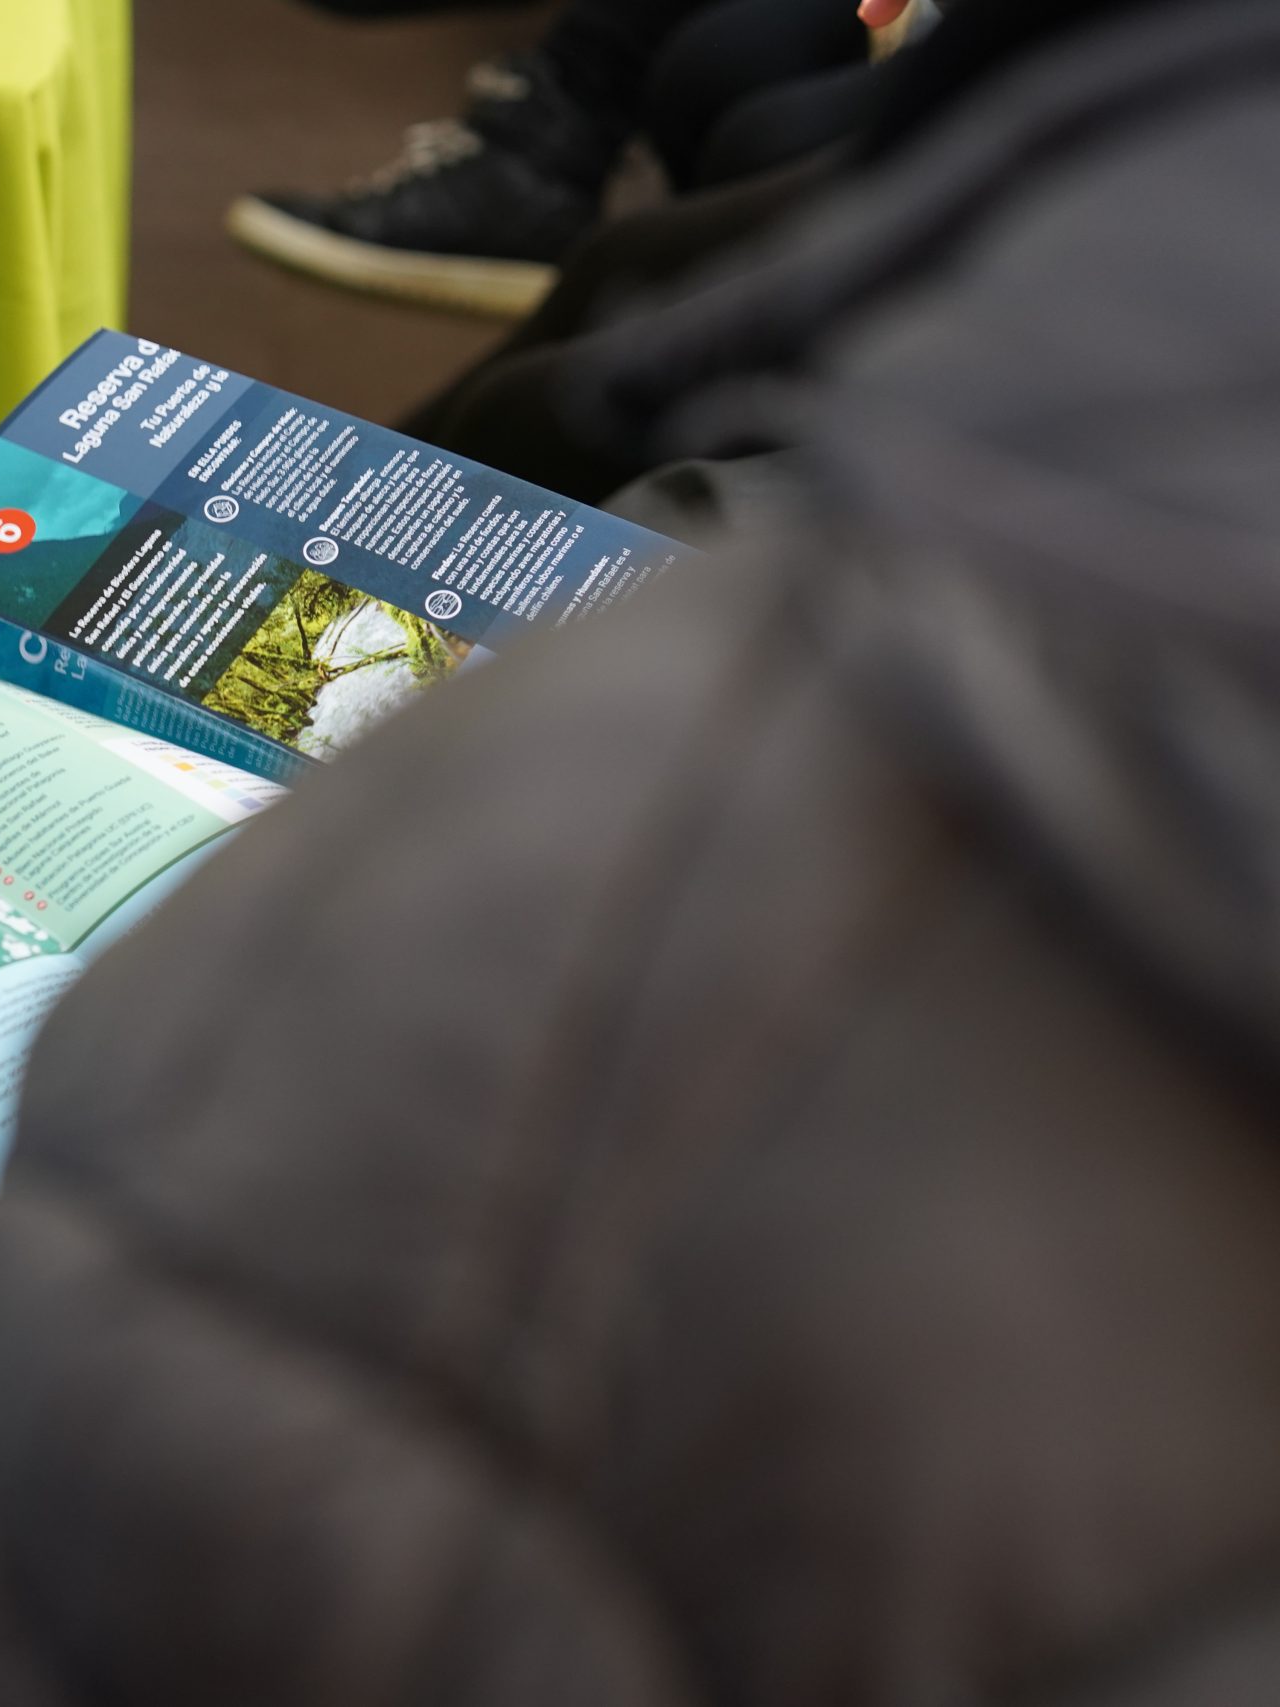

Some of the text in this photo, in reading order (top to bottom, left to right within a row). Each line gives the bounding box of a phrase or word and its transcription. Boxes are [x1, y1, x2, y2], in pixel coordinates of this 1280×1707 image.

[58, 338, 160, 430] Reserva d
[139, 364, 211, 430] Tu Puerta de
[149, 370, 229, 448] Naturaleza y la
[62, 409, 121, 464] Laguna
[112, 381, 148, 410] San
[187, 419, 242, 478] EN ELLA PUEDES
[318, 502, 346, 532] Bosques
[391, 515, 411, 535] Estos
[405, 488, 433, 516] bosques
[427, 463, 453, 489] también
[415, 477, 426, 488] de
[419, 509, 431, 519] un
[427, 490, 445, 511] papel
[452, 469, 463, 479] en
[396, 557, 408, 566] la
[404, 532, 428, 558] captura
[423, 522, 435, 533] de
[431, 496, 455, 524] carbono
[453, 485, 465, 493] la
[410, 497, 471, 570] conservación del suelo.
[431, 495, 502, 580] Fiordos: La Reserva cuenta
[445, 513, 505, 585] con una red de fiordos,
[456, 562, 480, 590] canales
[480, 535, 501, 559] costas
[497, 522, 511, 536] que
[507, 509, 520, 524] son
[466, 519, 528, 595] fundamentales para las
[479, 569, 506, 601] especies
[501, 542, 526, 571] marinas
[526, 509, 554, 538] costeras,
[489, 568, 522, 606] incluyendo
[518, 552, 534, 569] aves
[529, 515, 562, 553] migratorias
[529, 545, 554, 574] marinos
[550, 526, 568, 547] como
[68, 529, 162, 639] La Reserva de Biosfera Laguna
[84, 628, 101, 645] San
[96, 603, 121, 630] Rafael
[121, 589, 133, 600] El
[162, 541, 173, 552] es
[512, 586, 542, 616] ballenas,
[534, 565, 555, 586] lobos
[550, 538, 575, 566] marinos
[575, 524, 584, 533] el
[540, 575, 564, 601] chileno.
[575, 555, 610, 597] Humedales:
[588, 547, 631, 602] San Rafael es el
